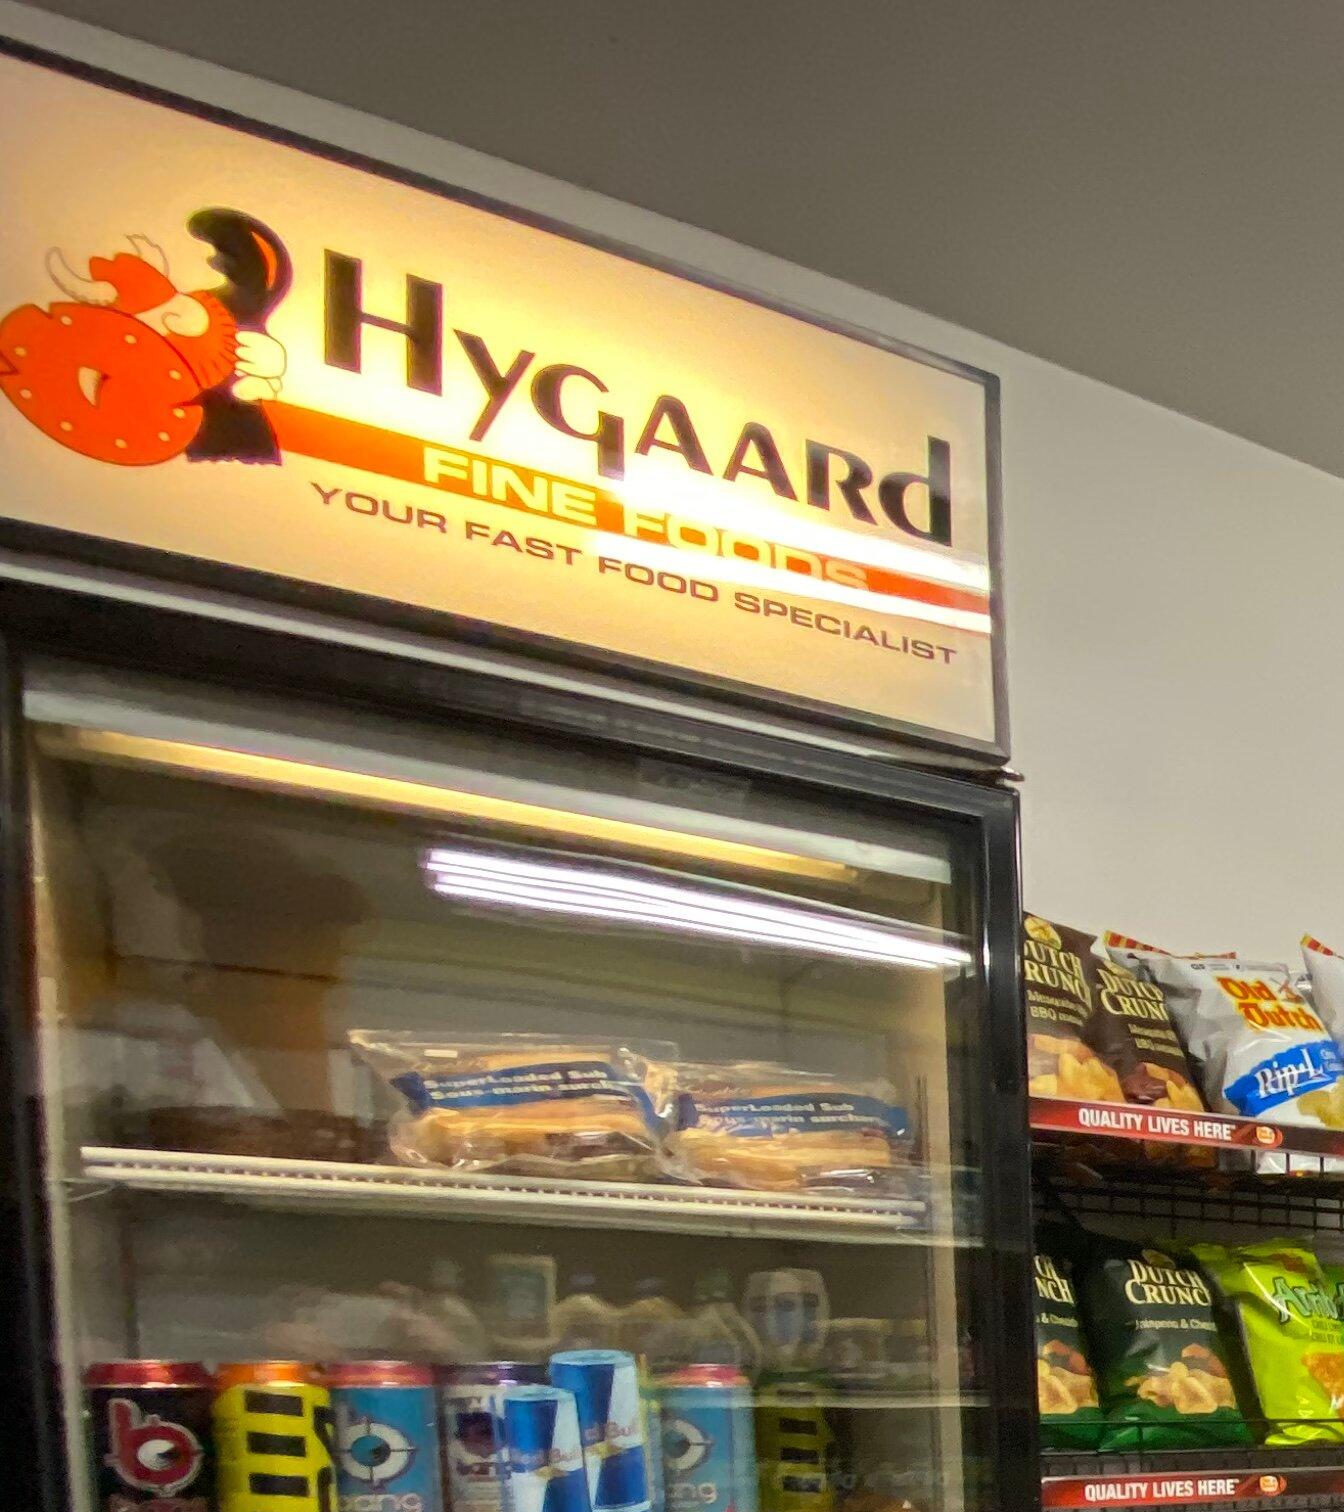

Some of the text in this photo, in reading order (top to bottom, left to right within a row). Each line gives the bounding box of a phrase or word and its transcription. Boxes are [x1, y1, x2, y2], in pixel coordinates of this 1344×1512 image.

[422, 445, 868, 596] FINE FOODS
[310, 483, 956, 665] YOUR FAST FOOD SPECIALIST
[1024, 960, 1092, 1013] RUNC
[1097, 968, 1163, 1001] DUTC
[1217, 976, 1277, 1000] Old
[1101, 989, 1169, 1021] CRUN
[1237, 1002, 1325, 1032] Dutch
[1078, 1108, 1236, 1141] QUALITY LIVES HERE
[1127, 1258, 1205, 1288] DUTCH
[1125, 1279, 1212, 1306] CRUNC
[1084, 1479, 1239, 1502] QUALITY LIVES HERE
